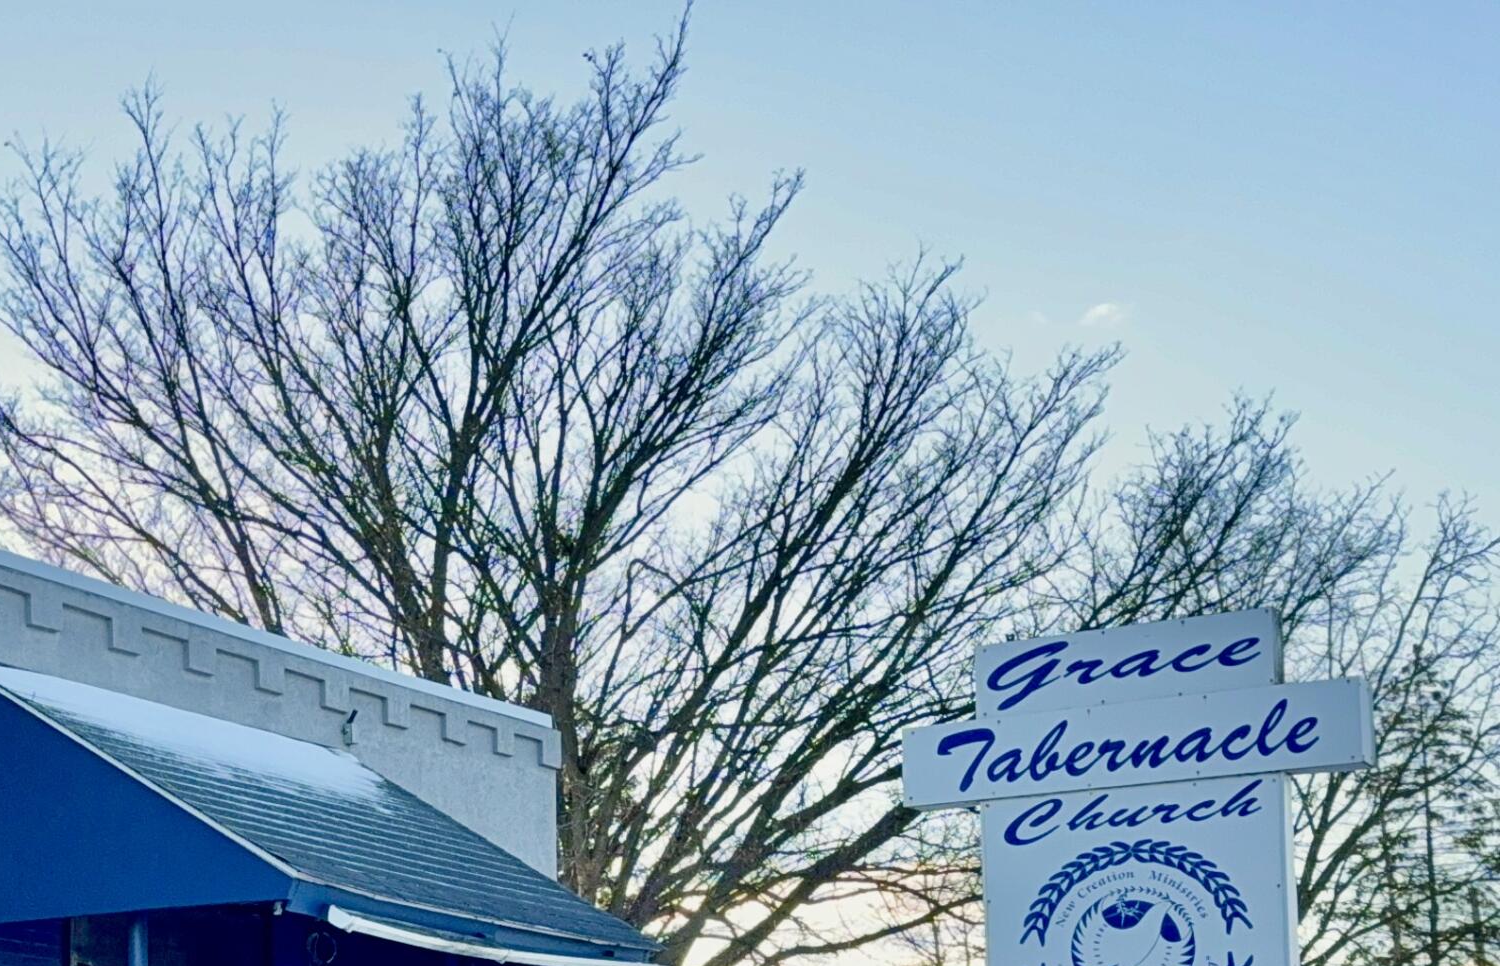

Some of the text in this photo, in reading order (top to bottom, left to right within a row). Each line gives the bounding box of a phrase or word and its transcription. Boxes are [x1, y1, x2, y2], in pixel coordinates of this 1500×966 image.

[986, 636, 1261, 711] Grace
[936, 698, 1321, 792] Tabernacle
[1003, 779, 1263, 846] Church
[1055, 870, 1209, 928] New Creation Ministries
